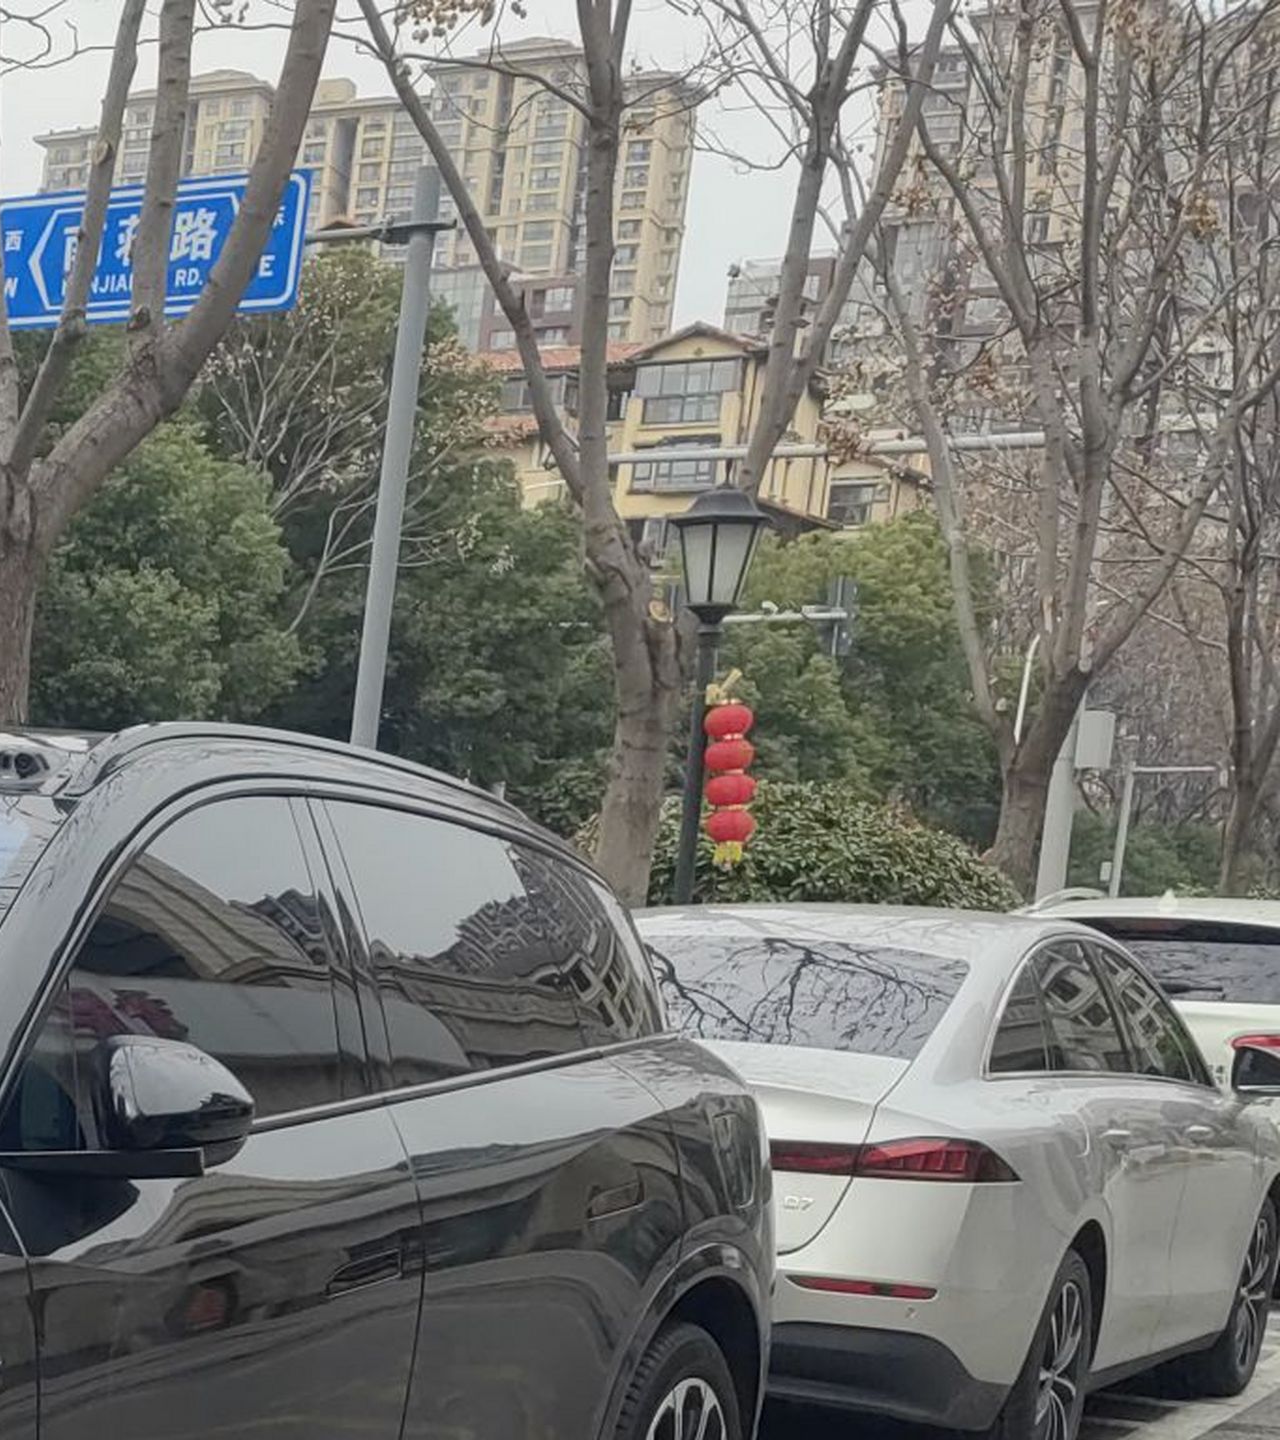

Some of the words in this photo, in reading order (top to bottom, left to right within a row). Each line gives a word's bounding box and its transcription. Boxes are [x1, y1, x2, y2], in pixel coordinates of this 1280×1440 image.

[4, 229, 24, 252] 西
[174, 267, 203, 288] RD.
[259, 254, 276, 278] E
